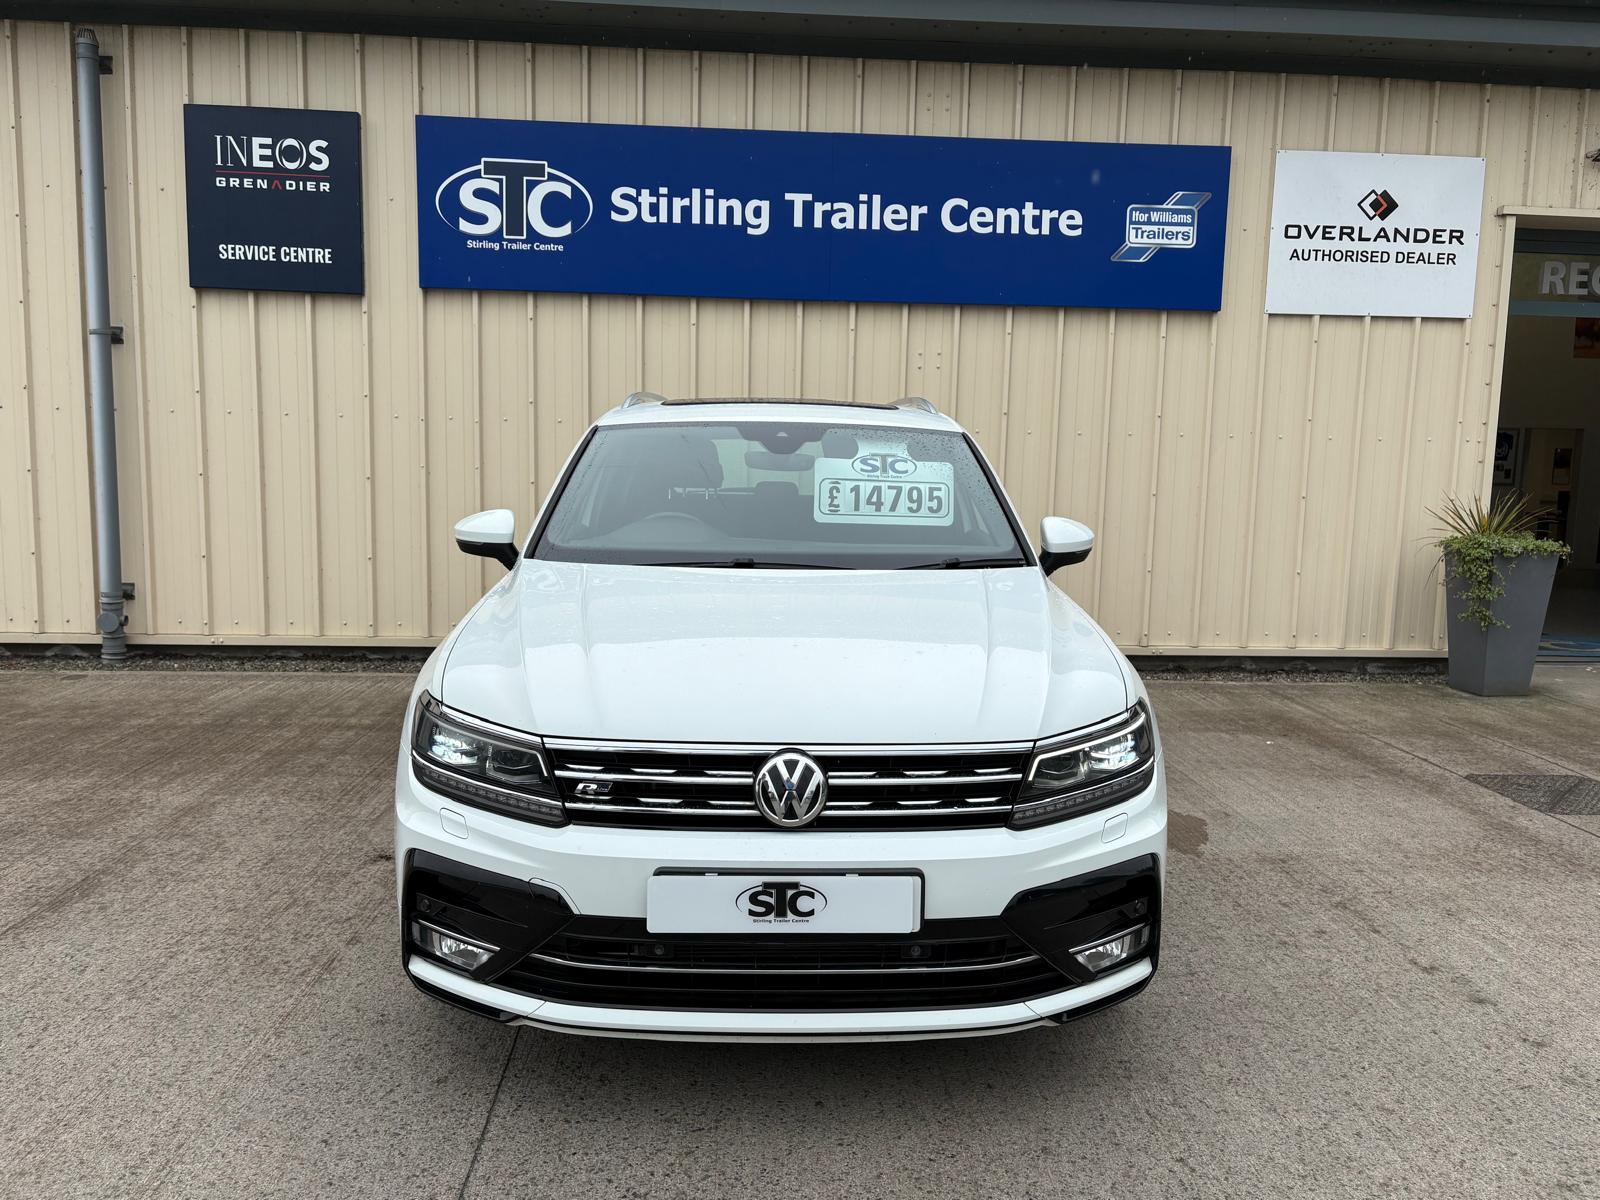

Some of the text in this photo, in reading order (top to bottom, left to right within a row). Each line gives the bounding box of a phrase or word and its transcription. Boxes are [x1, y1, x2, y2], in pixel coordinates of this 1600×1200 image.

[214, 134, 330, 171] INEOS
[215, 177, 331, 192] GRENADIER
[458, 157, 572, 239] STC
[610, 186, 1083, 236] Stirling Trailer Centre
[1132, 210, 1192, 223] Ifor Williams
[1132, 226, 1191, 241] Trailers
[1284, 224, 1464, 245] OVERLANDER
[218, 243, 333, 264] SERVICE CENTRE
[466, 239, 564, 251] Stirling Trailer Centre
[1289, 248, 1457, 266] AUTHORISED DEALER
[859, 452, 909, 475] STC
[747, 881, 816, 918] STC
